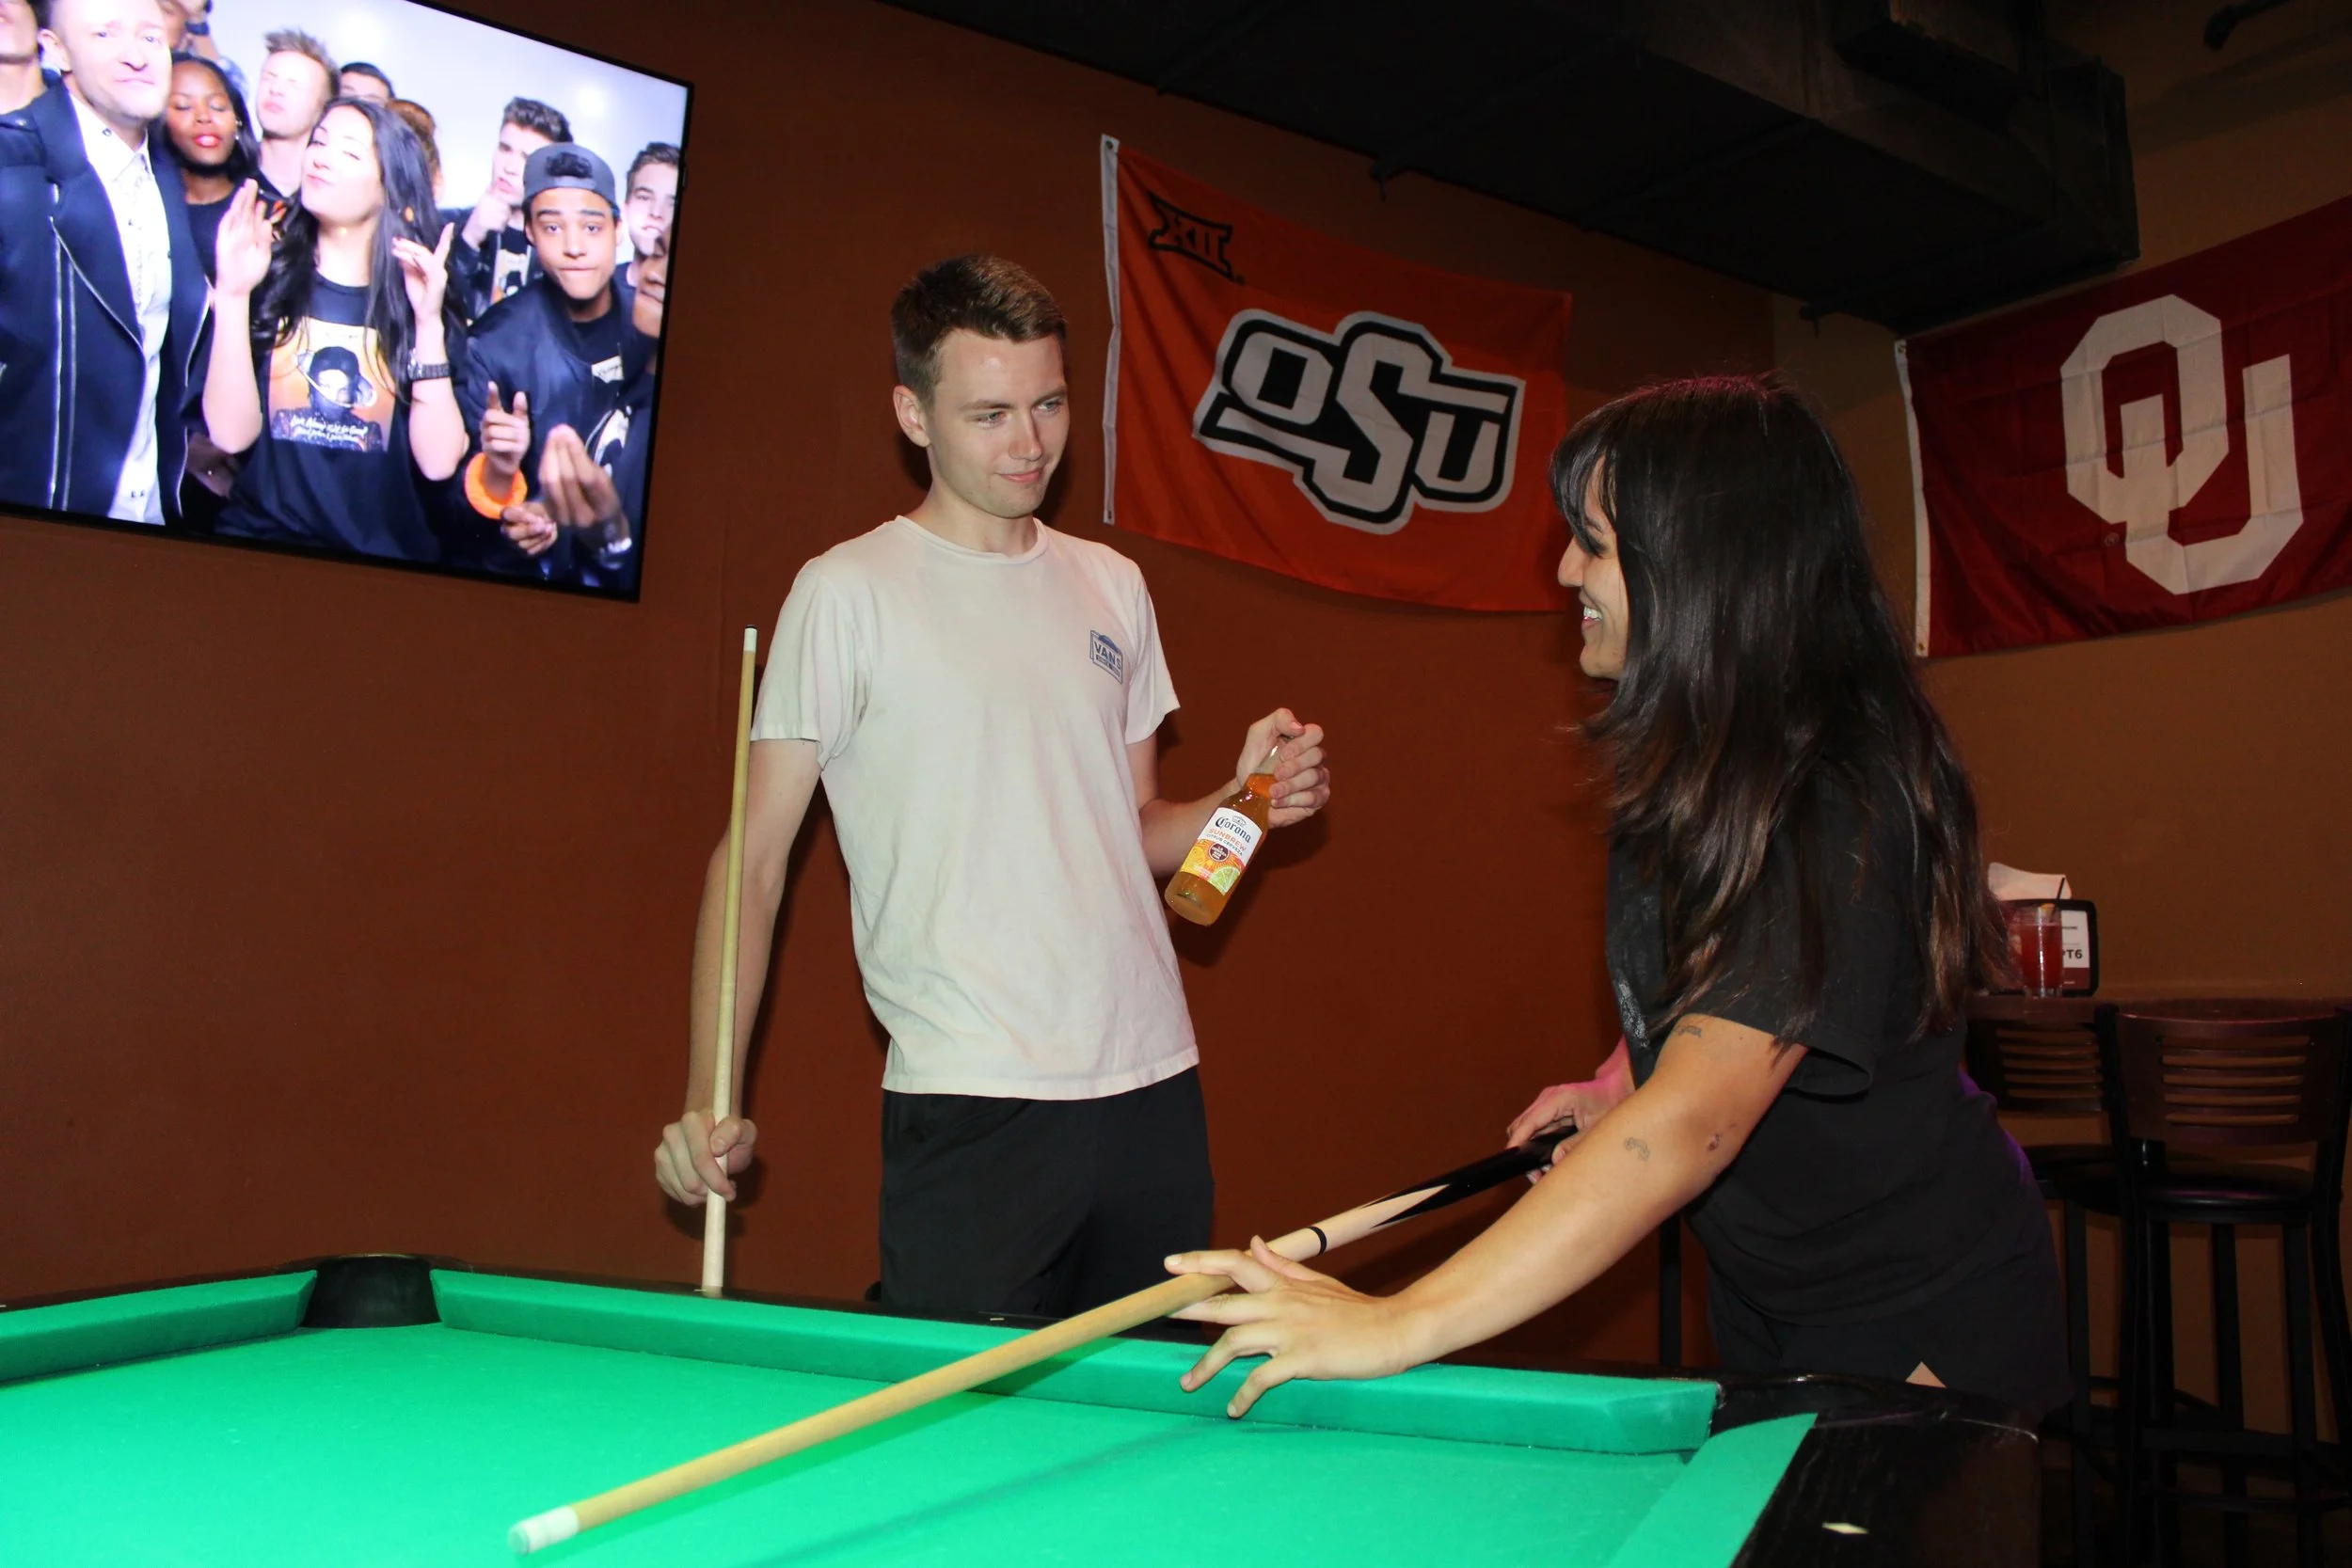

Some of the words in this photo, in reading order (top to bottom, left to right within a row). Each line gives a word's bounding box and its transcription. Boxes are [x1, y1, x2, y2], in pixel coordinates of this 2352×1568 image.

[1194, 310, 1525, 533] OSU
[2060, 293, 2304, 595] OU
[1093, 640, 1121, 671] VANS
[1208, 828, 1248, 852] SUNBREW
[1215, 816, 1251, 844] Corona
[1222, 839, 1244, 857] CERVEZA
